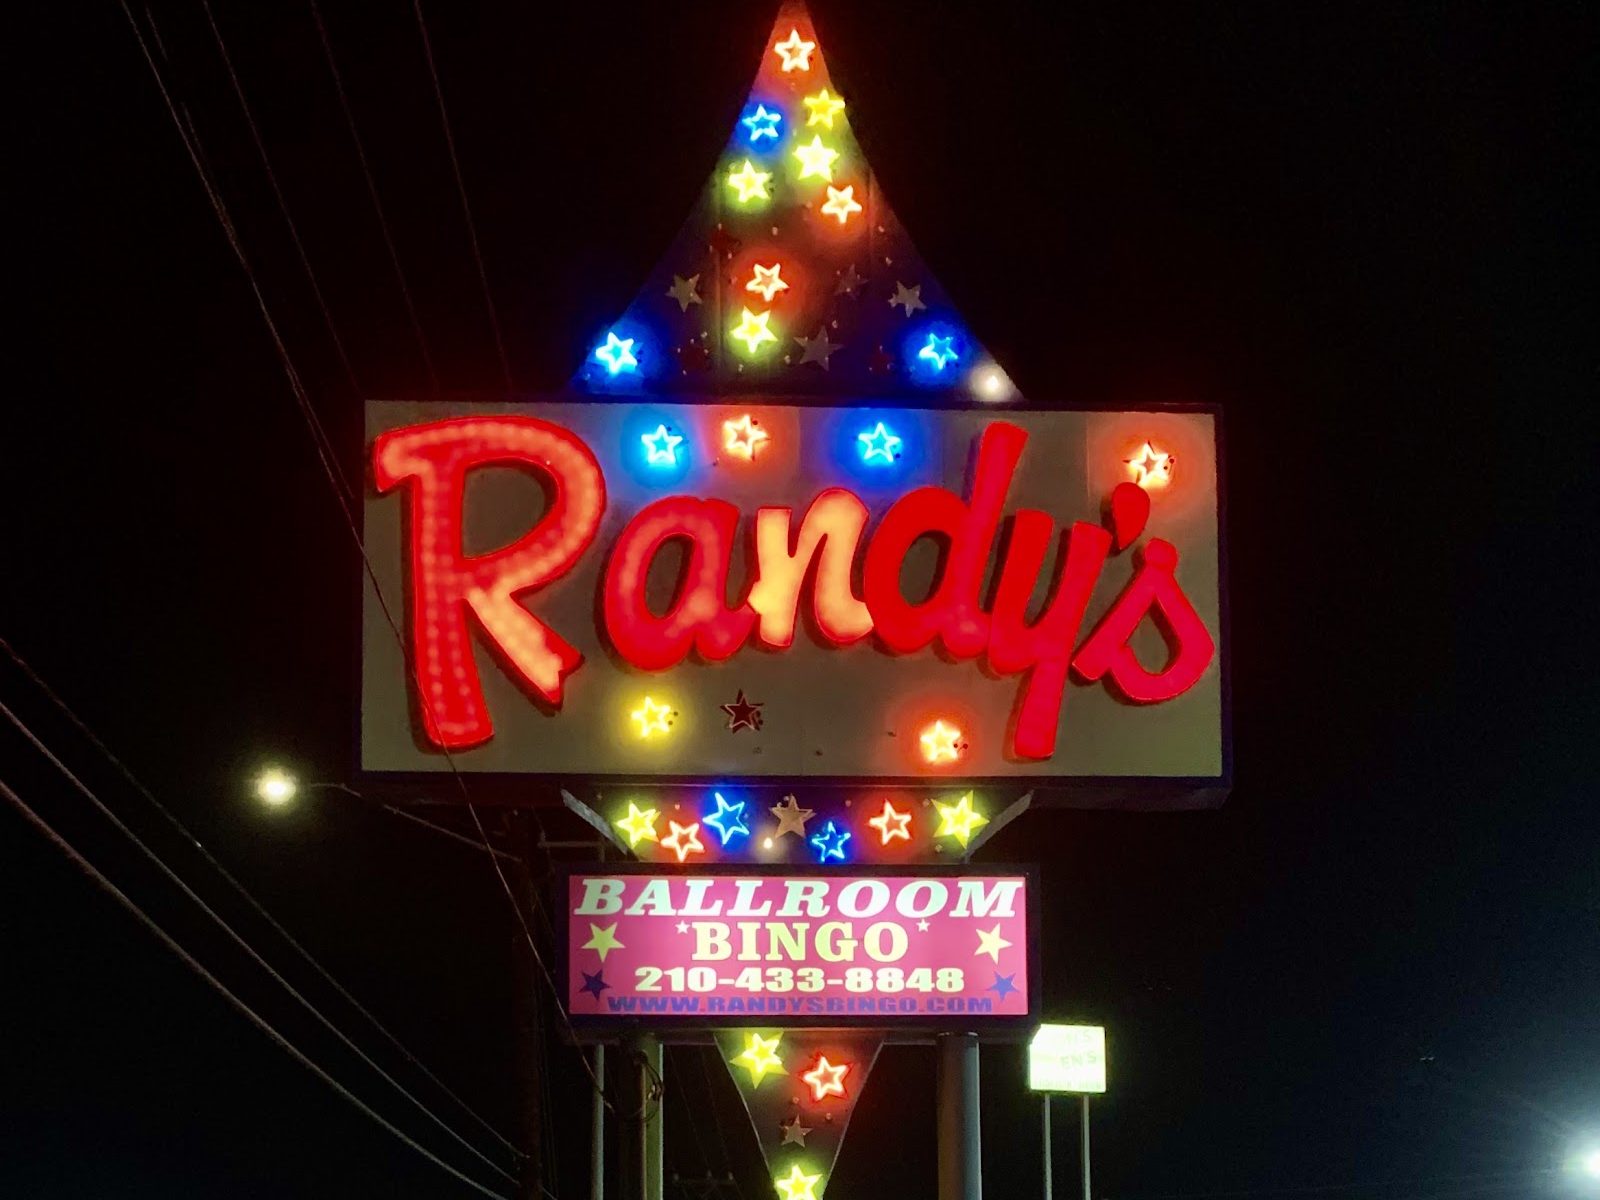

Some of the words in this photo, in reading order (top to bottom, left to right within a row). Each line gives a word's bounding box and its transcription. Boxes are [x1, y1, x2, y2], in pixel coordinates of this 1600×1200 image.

[375, 415, 1214, 760] Randy's
[574, 879, 1023, 917] BALLROOM
[692, 921, 908, 961] BINGO
[634, 967, 965, 992] 210-433-8848
[607, 996, 993, 1013] WWW.RANDYSBINGO.COM
